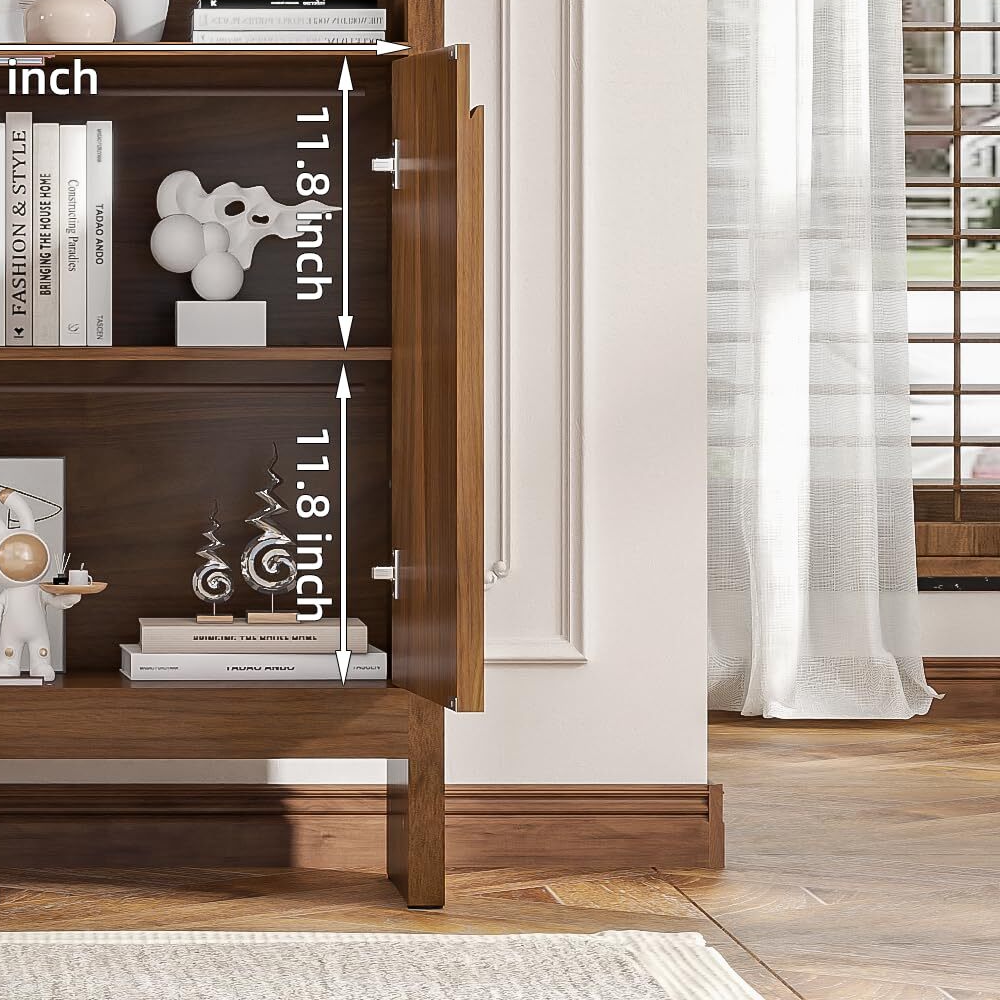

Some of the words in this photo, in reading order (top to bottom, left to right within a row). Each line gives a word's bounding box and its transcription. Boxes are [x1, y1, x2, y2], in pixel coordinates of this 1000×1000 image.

[12, 130, 27, 195] STYLE
[39, 173, 51, 198] HOME
[12, 200, 27, 217] &
[39, 200, 51, 230] HOUSE
[65, 179, 80, 234] Constructing
[95, 203, 104, 236] TADAO
[39, 232, 51, 250] THE
[67, 236, 80, 272] Paradies
[95, 238, 104, 265] ANDO
[12, 223, 27, 316] FASHION
[39, 252, 51, 296] BRINGING
